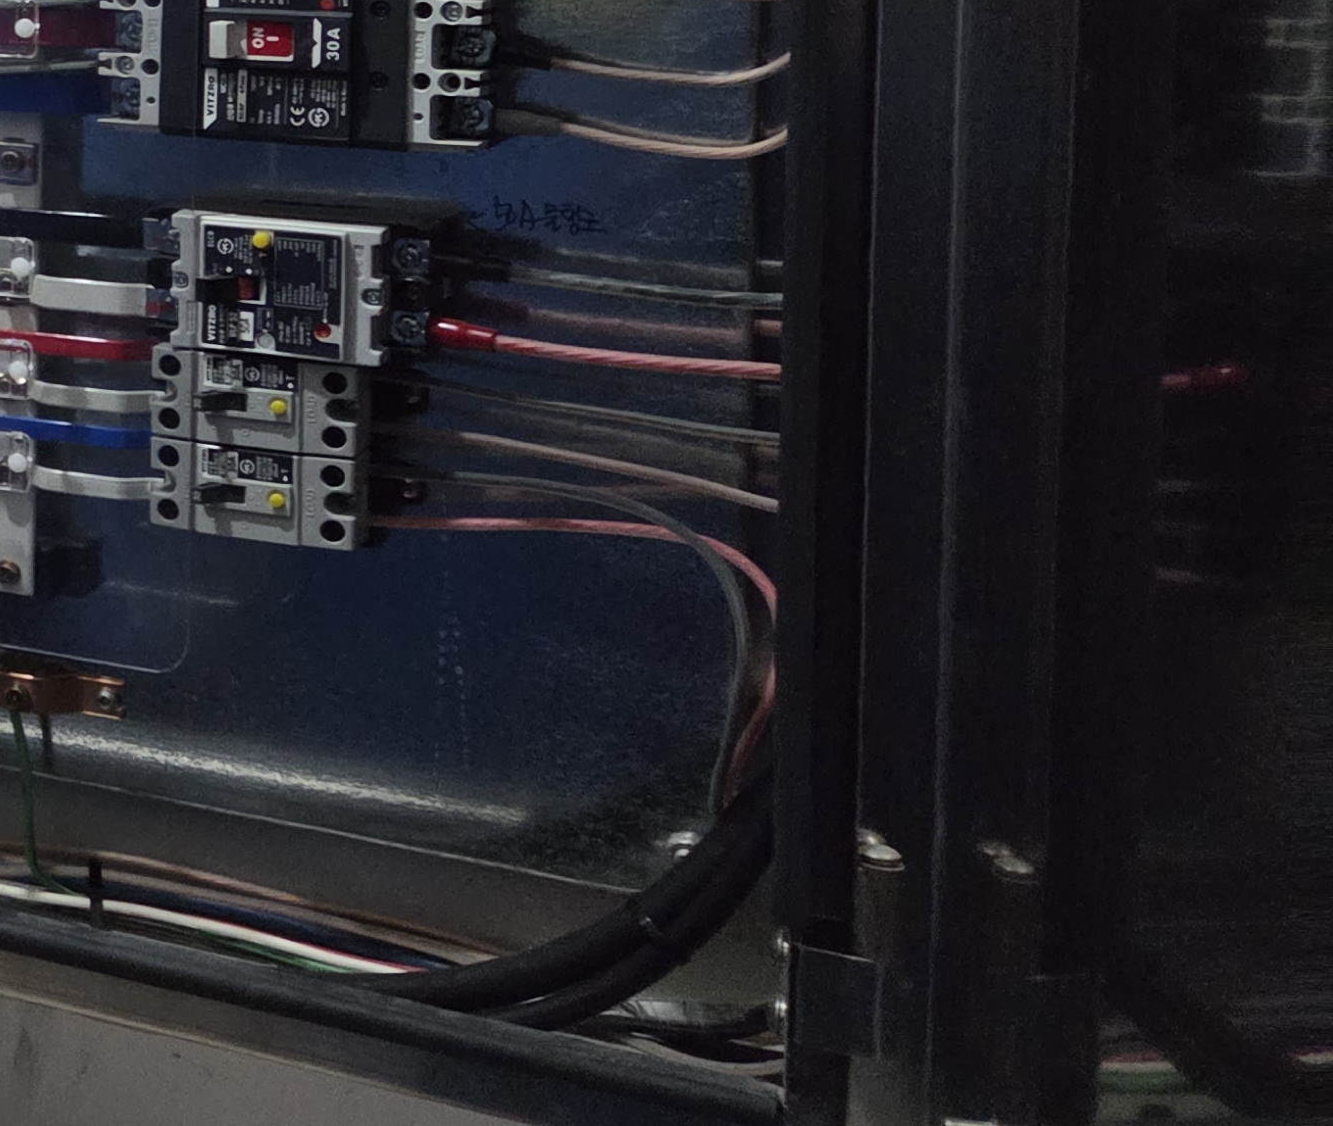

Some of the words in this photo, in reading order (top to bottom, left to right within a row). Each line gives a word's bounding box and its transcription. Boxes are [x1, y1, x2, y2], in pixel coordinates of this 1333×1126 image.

[252, 27, 265, 49] ON
[326, 27, 341, 62] 30A
[207, 76, 215, 117] VITZRO
[207, 304, 216, 341] VITZRO
